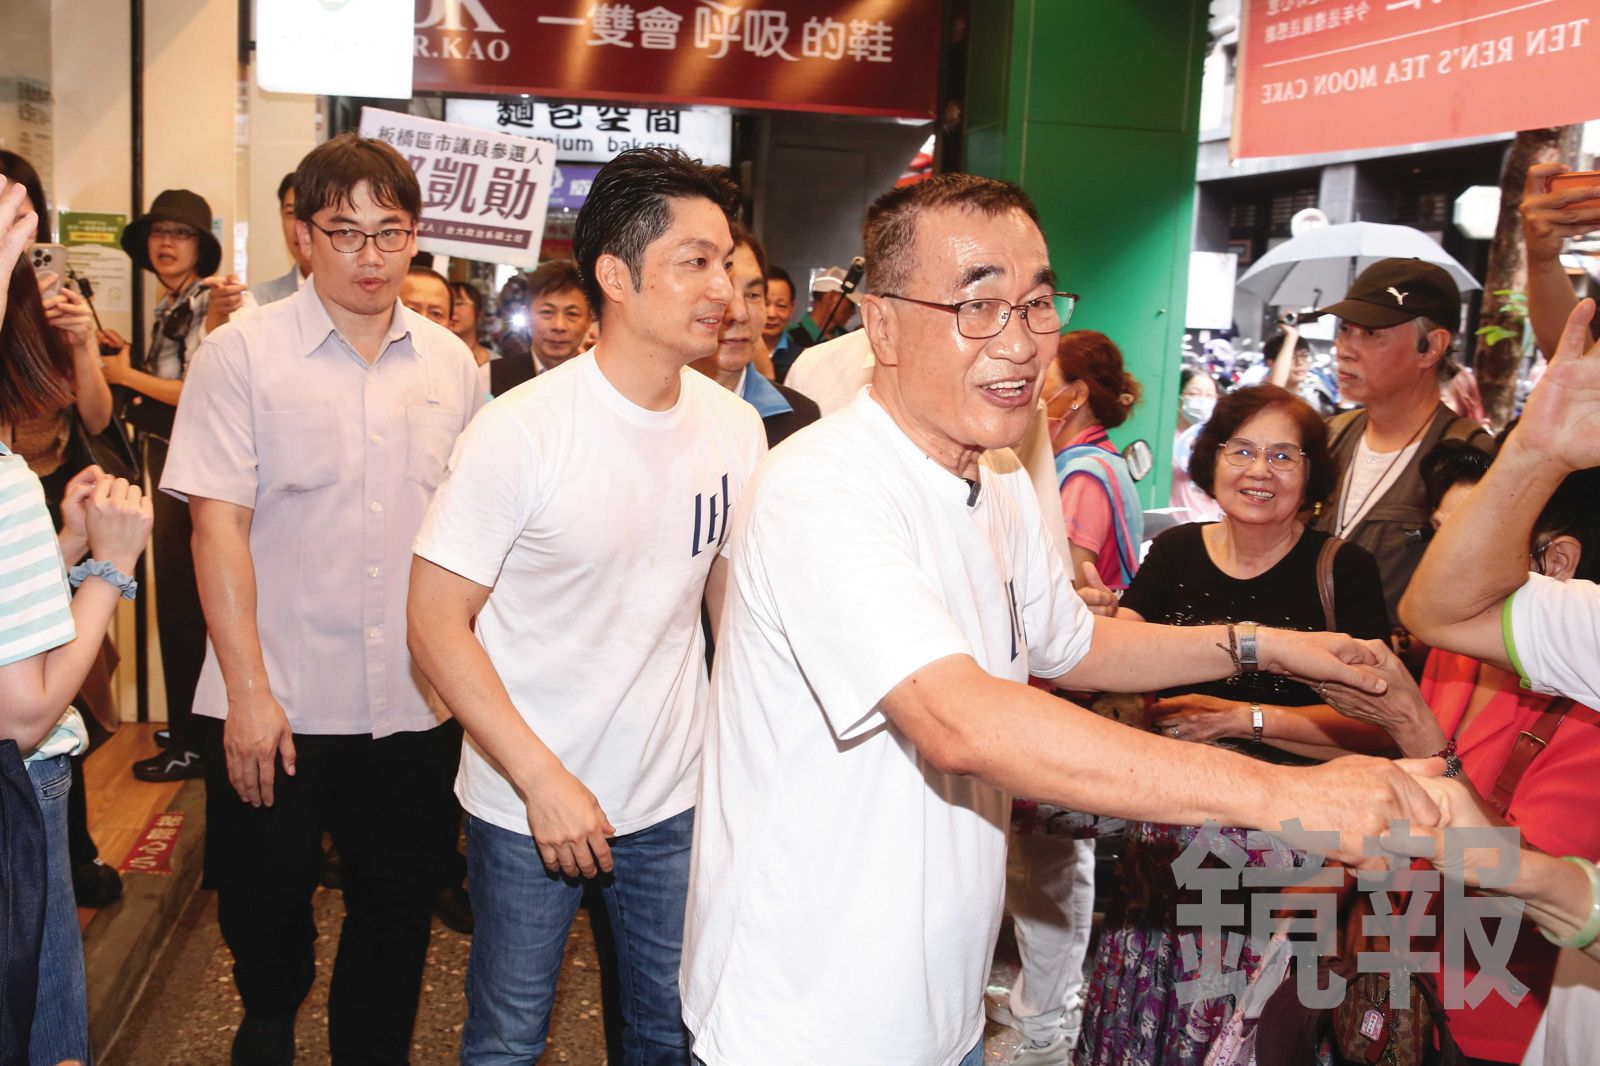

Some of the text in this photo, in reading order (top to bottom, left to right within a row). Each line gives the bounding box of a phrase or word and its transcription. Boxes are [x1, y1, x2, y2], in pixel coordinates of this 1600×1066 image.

[537, 0, 893, 62] 一雙會呼吸的鞋
[497, 100, 680, 134] 麵包空間
[378, 125, 543, 166] 板橋區市議員參選人
[409, 154, 537, 221] 凱勛
